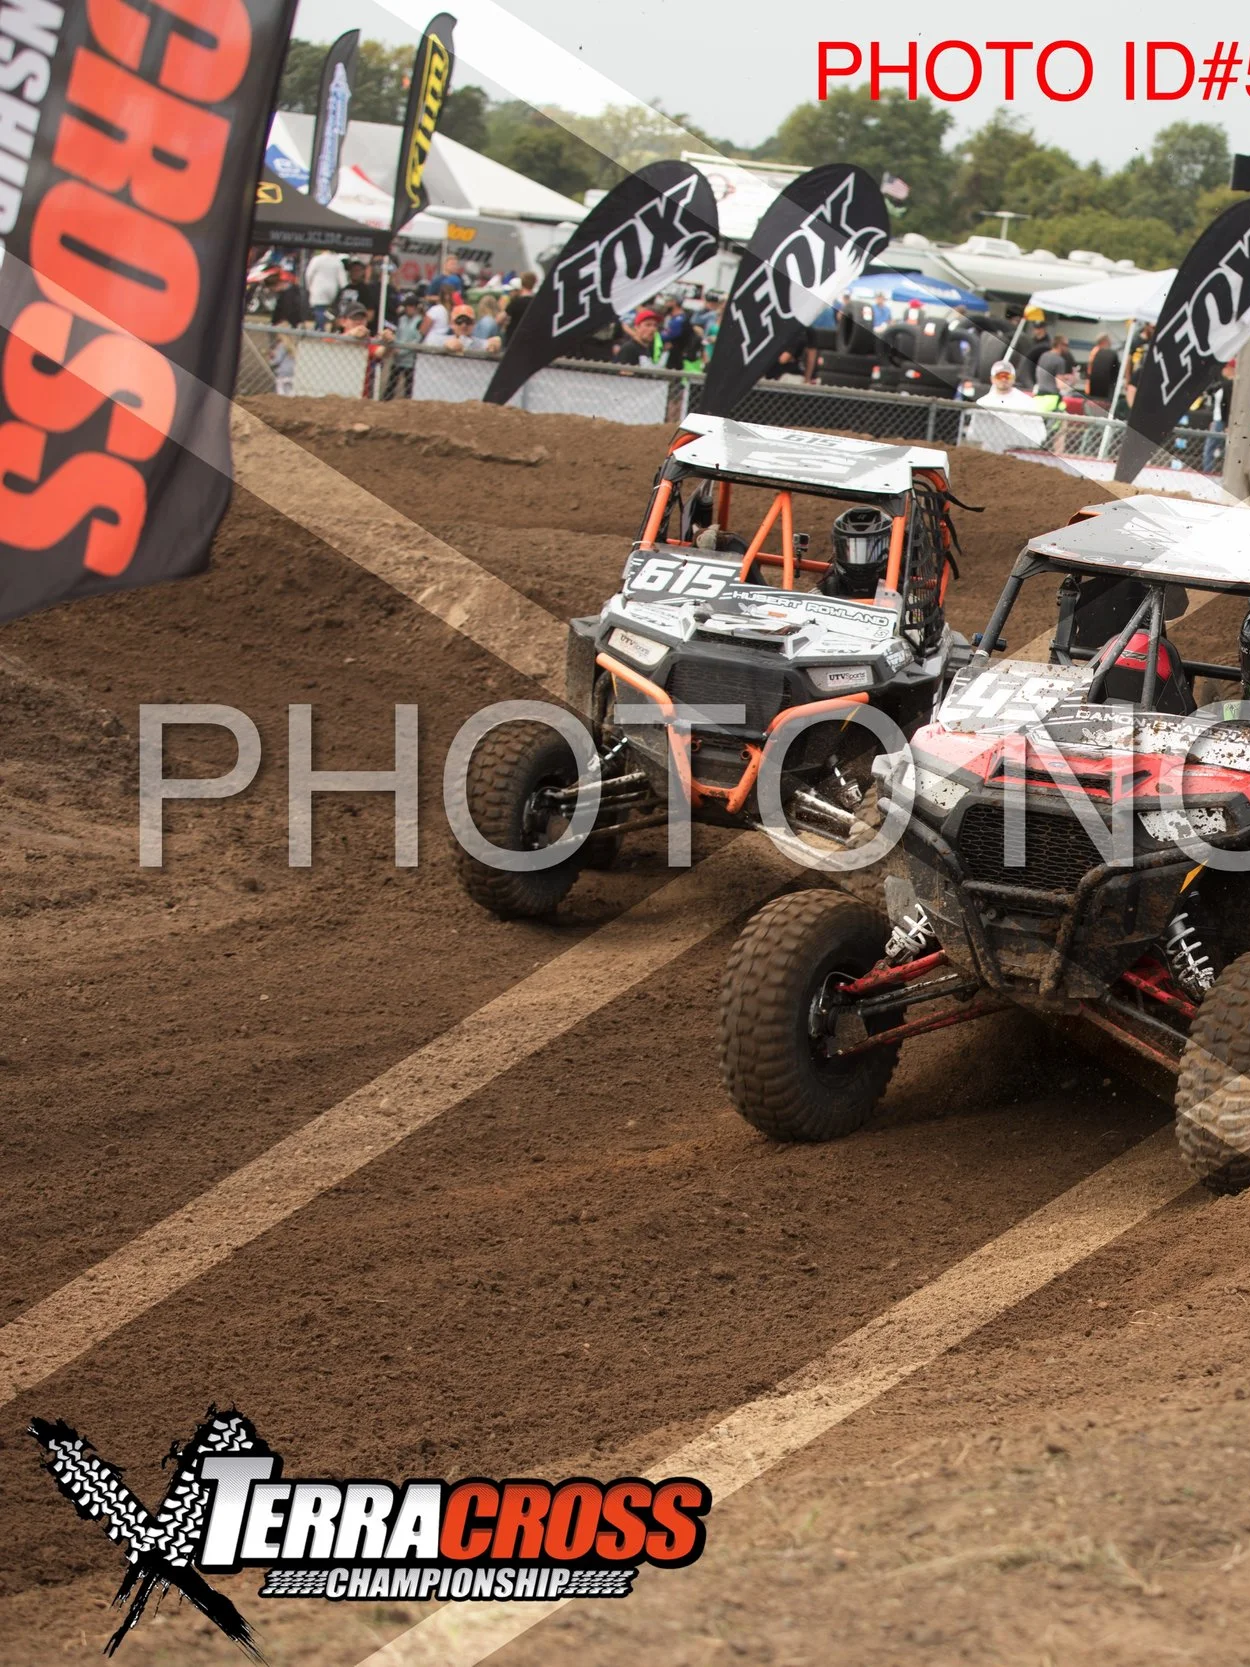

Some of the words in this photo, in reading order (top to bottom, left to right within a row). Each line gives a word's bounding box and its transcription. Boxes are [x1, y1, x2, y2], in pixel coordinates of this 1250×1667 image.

[552, 173, 717, 338] FOX
[731, 171, 887, 366] FOX
[631, 558, 737, 599] 615
[732, 590, 803, 610] HUBERT
[806, 603, 890, 627] ROWLAND
[1076, 709, 1146, 730] DAMON
